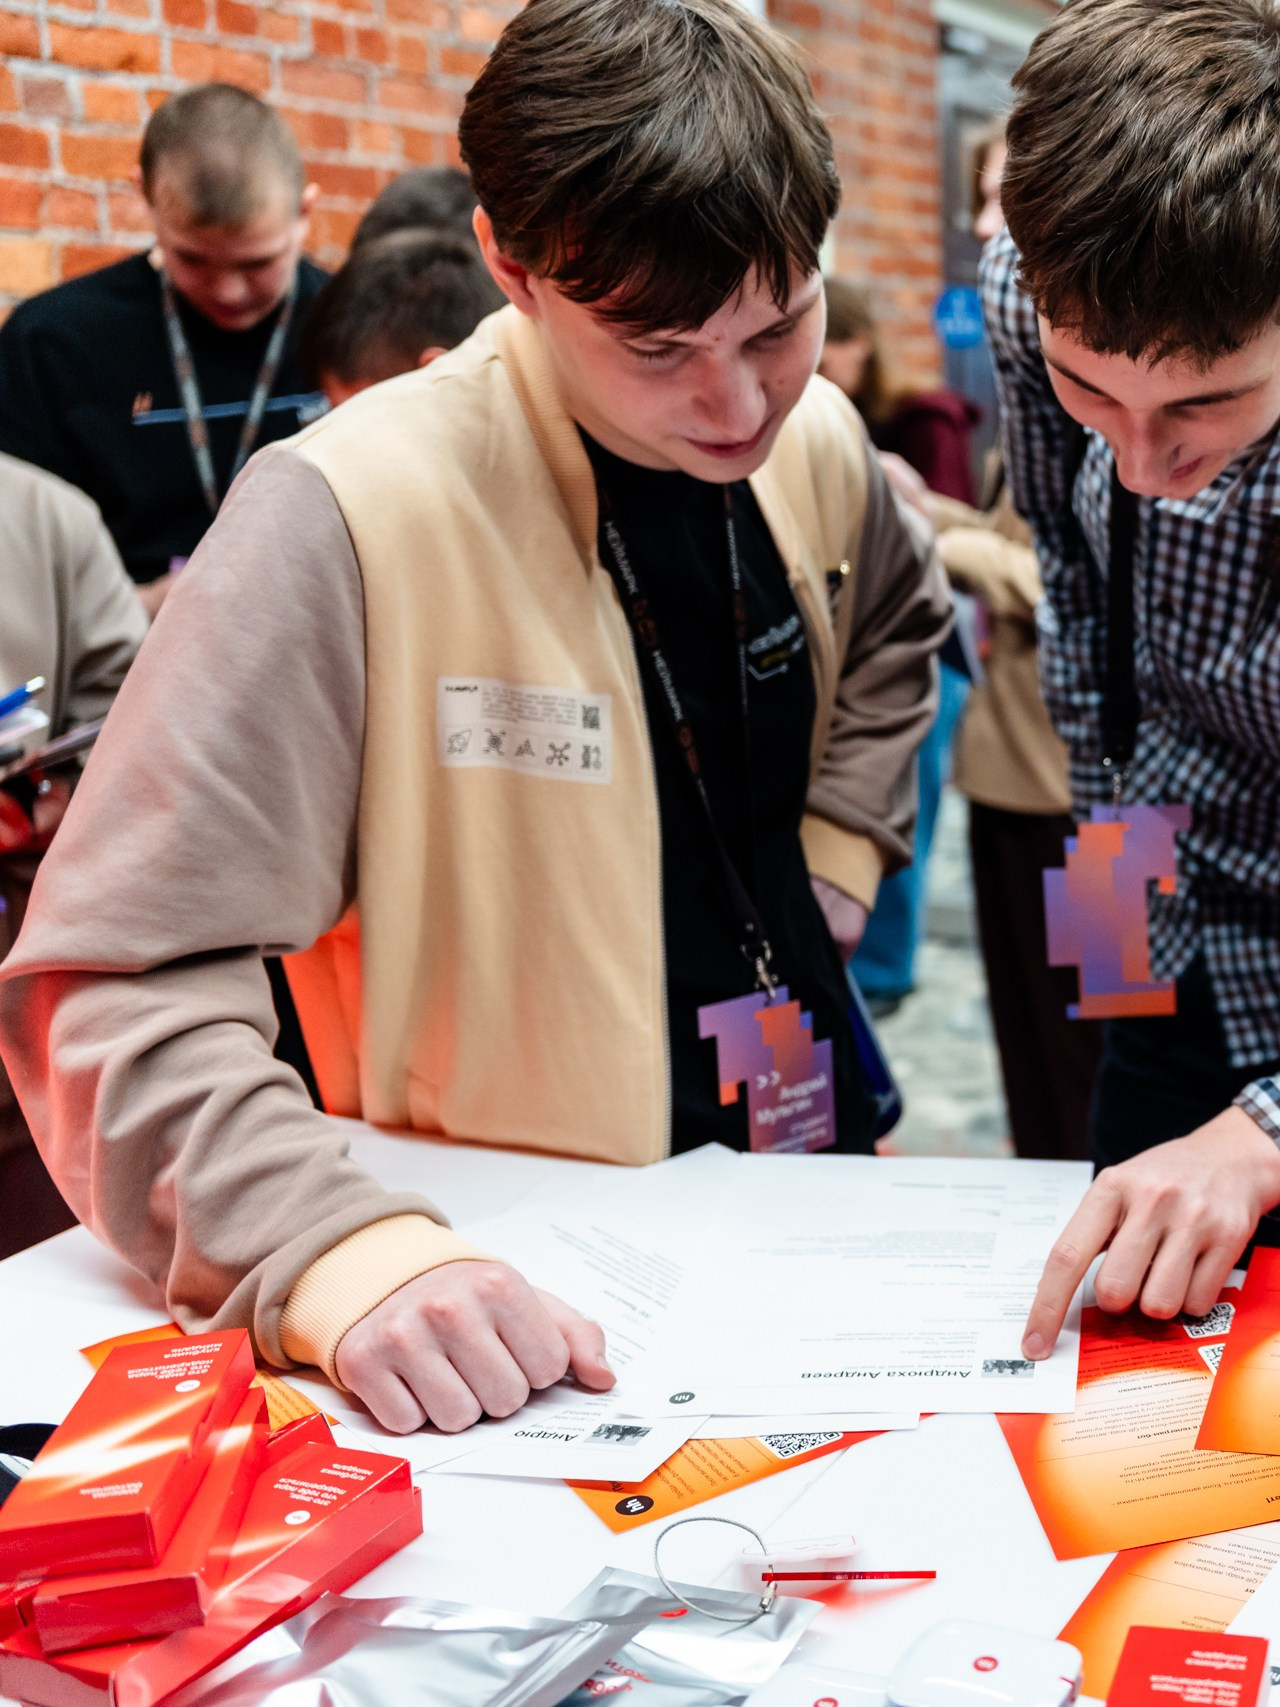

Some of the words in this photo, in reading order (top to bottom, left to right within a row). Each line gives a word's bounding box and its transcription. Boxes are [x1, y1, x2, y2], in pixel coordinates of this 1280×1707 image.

[605, 521, 639, 595] НЕЙМАРК
[163, 1345, 220, 1359] клубника
[170, 1342, 223, 1354] миндаль
[127, 1359, 213, 1377] подкрепиться
[887, 1369, 971, 1378] Андрюха
[801, 1370, 881, 1379] Андреев
[514, 1430, 577, 1442] Андрю
[1137, 1426, 1191, 1439] телеграм-бот
[1187, 1540, 1211, 1549] время
[1212, 1546, 1236, 1555] самое
[1173, 1560, 1224, 1575] авторизуйся
[1196, 1558, 1226, 1568] лучшие
[1233, 1559, 1254, 1567] тебя!
[1227, 1565, 1251, 1574] чтобы
